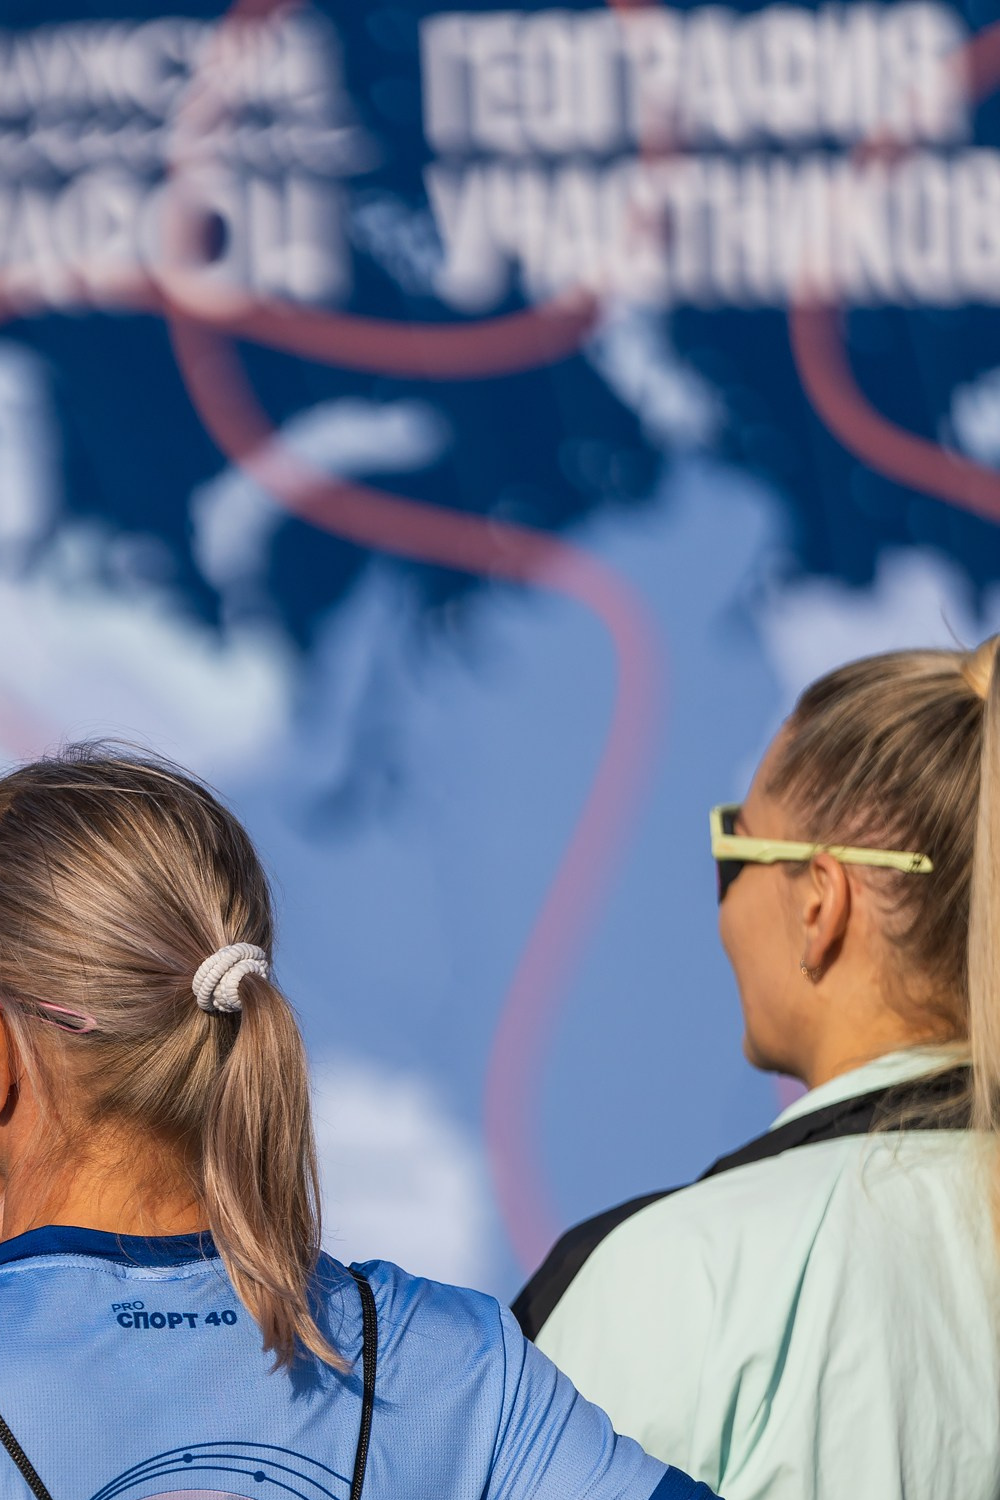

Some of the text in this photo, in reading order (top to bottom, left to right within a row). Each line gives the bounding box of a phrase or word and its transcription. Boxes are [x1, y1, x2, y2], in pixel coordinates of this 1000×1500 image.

[420, 8, 970, 152] ГЕОГРАФИЯ
[111, 1301, 145, 1312] PRO
[116, 1309, 238, 1329] СПОРТ 40
